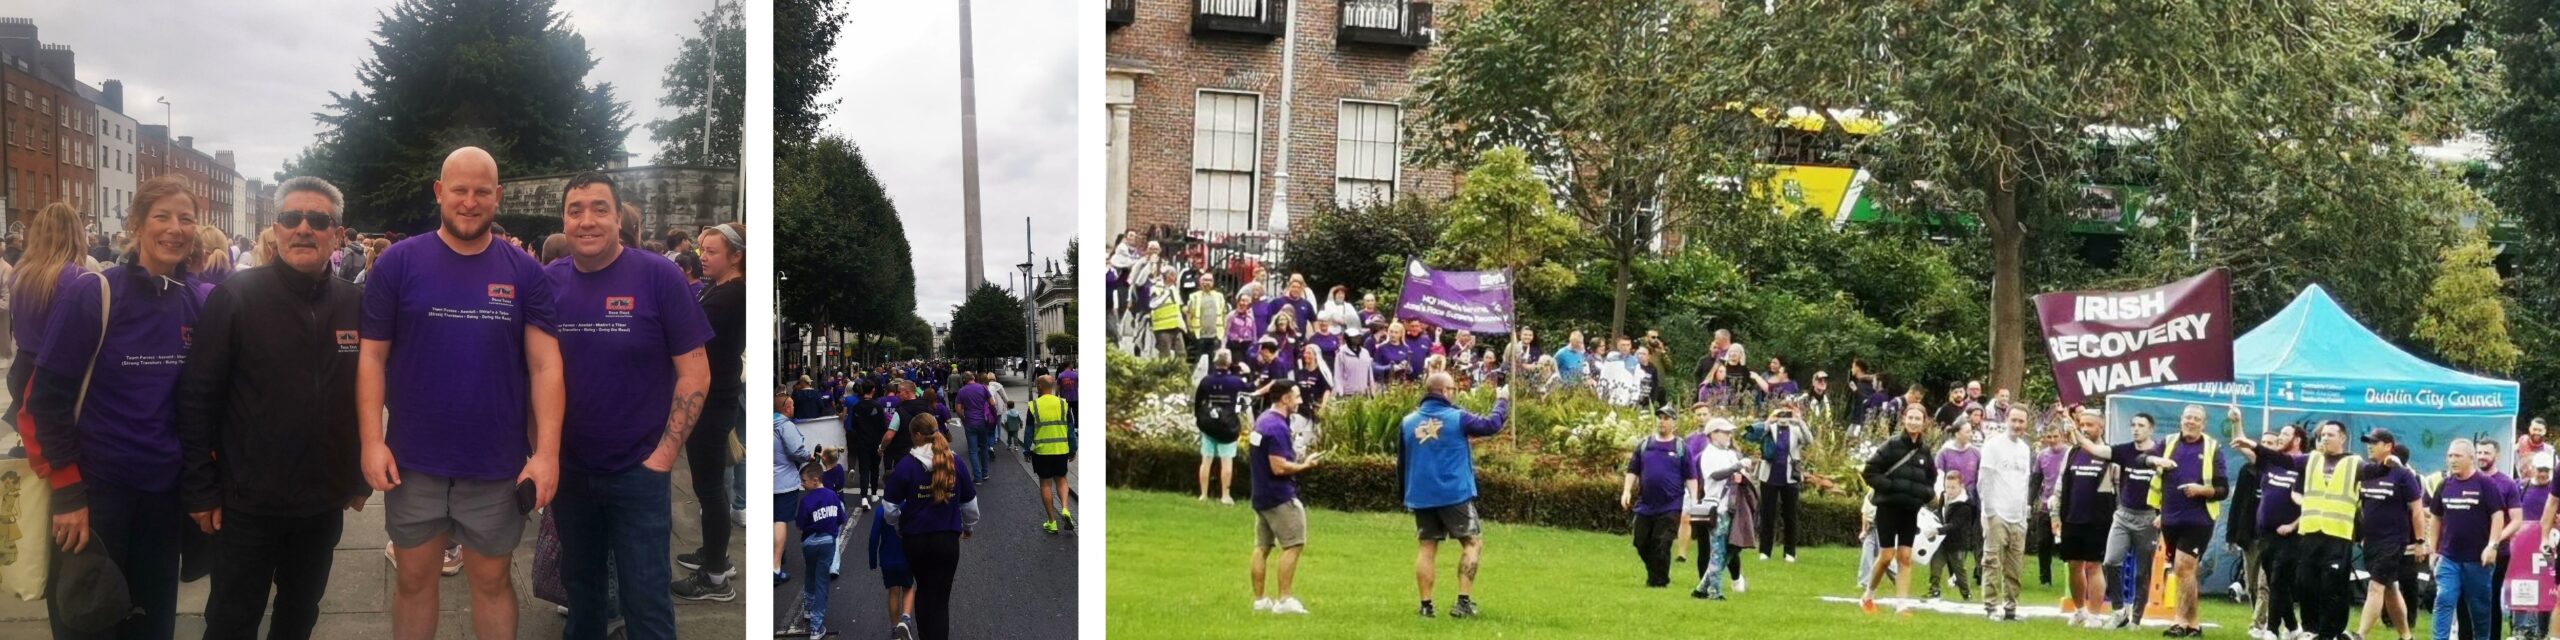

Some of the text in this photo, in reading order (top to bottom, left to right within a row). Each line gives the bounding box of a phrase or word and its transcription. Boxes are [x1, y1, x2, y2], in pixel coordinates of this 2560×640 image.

[2074, 290, 2165, 322] IRISH
[2049, 313, 2211, 362] RECOVERY
[2077, 355, 2178, 396] WALK
[2364, 387, 2504, 410] Dublin City Council
